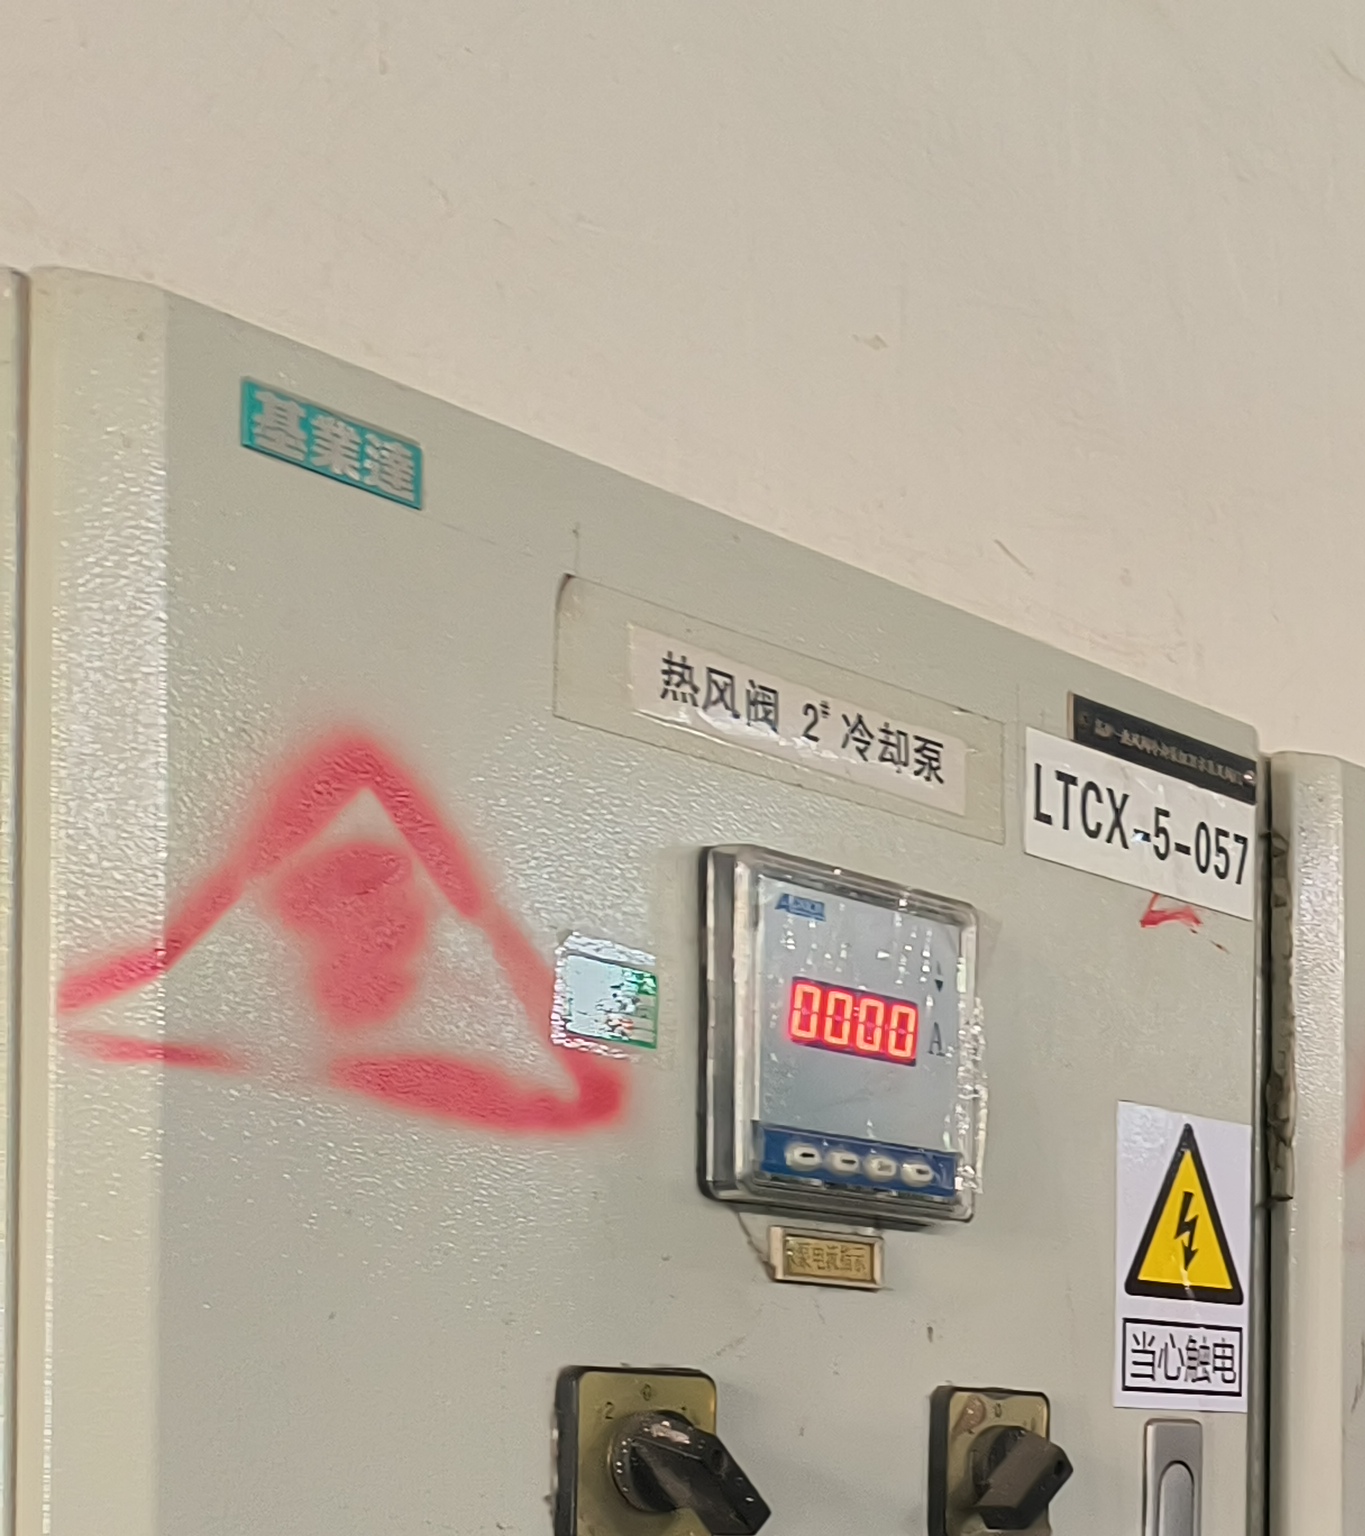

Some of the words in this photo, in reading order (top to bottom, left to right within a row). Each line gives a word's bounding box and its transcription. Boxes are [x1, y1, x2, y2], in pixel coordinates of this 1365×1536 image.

[250, 388, 417, 502] 基業達
[659, 650, 780, 733] 热风阀
[841, 712, 946, 786] 冷却泵
[1033, 762, 1249, 885] LTCX-5-057
[791, 982, 918, 1060] 0000
[928, 1021, 946, 1057] A
[1130, 1330, 1237, 1384] 当心触电
